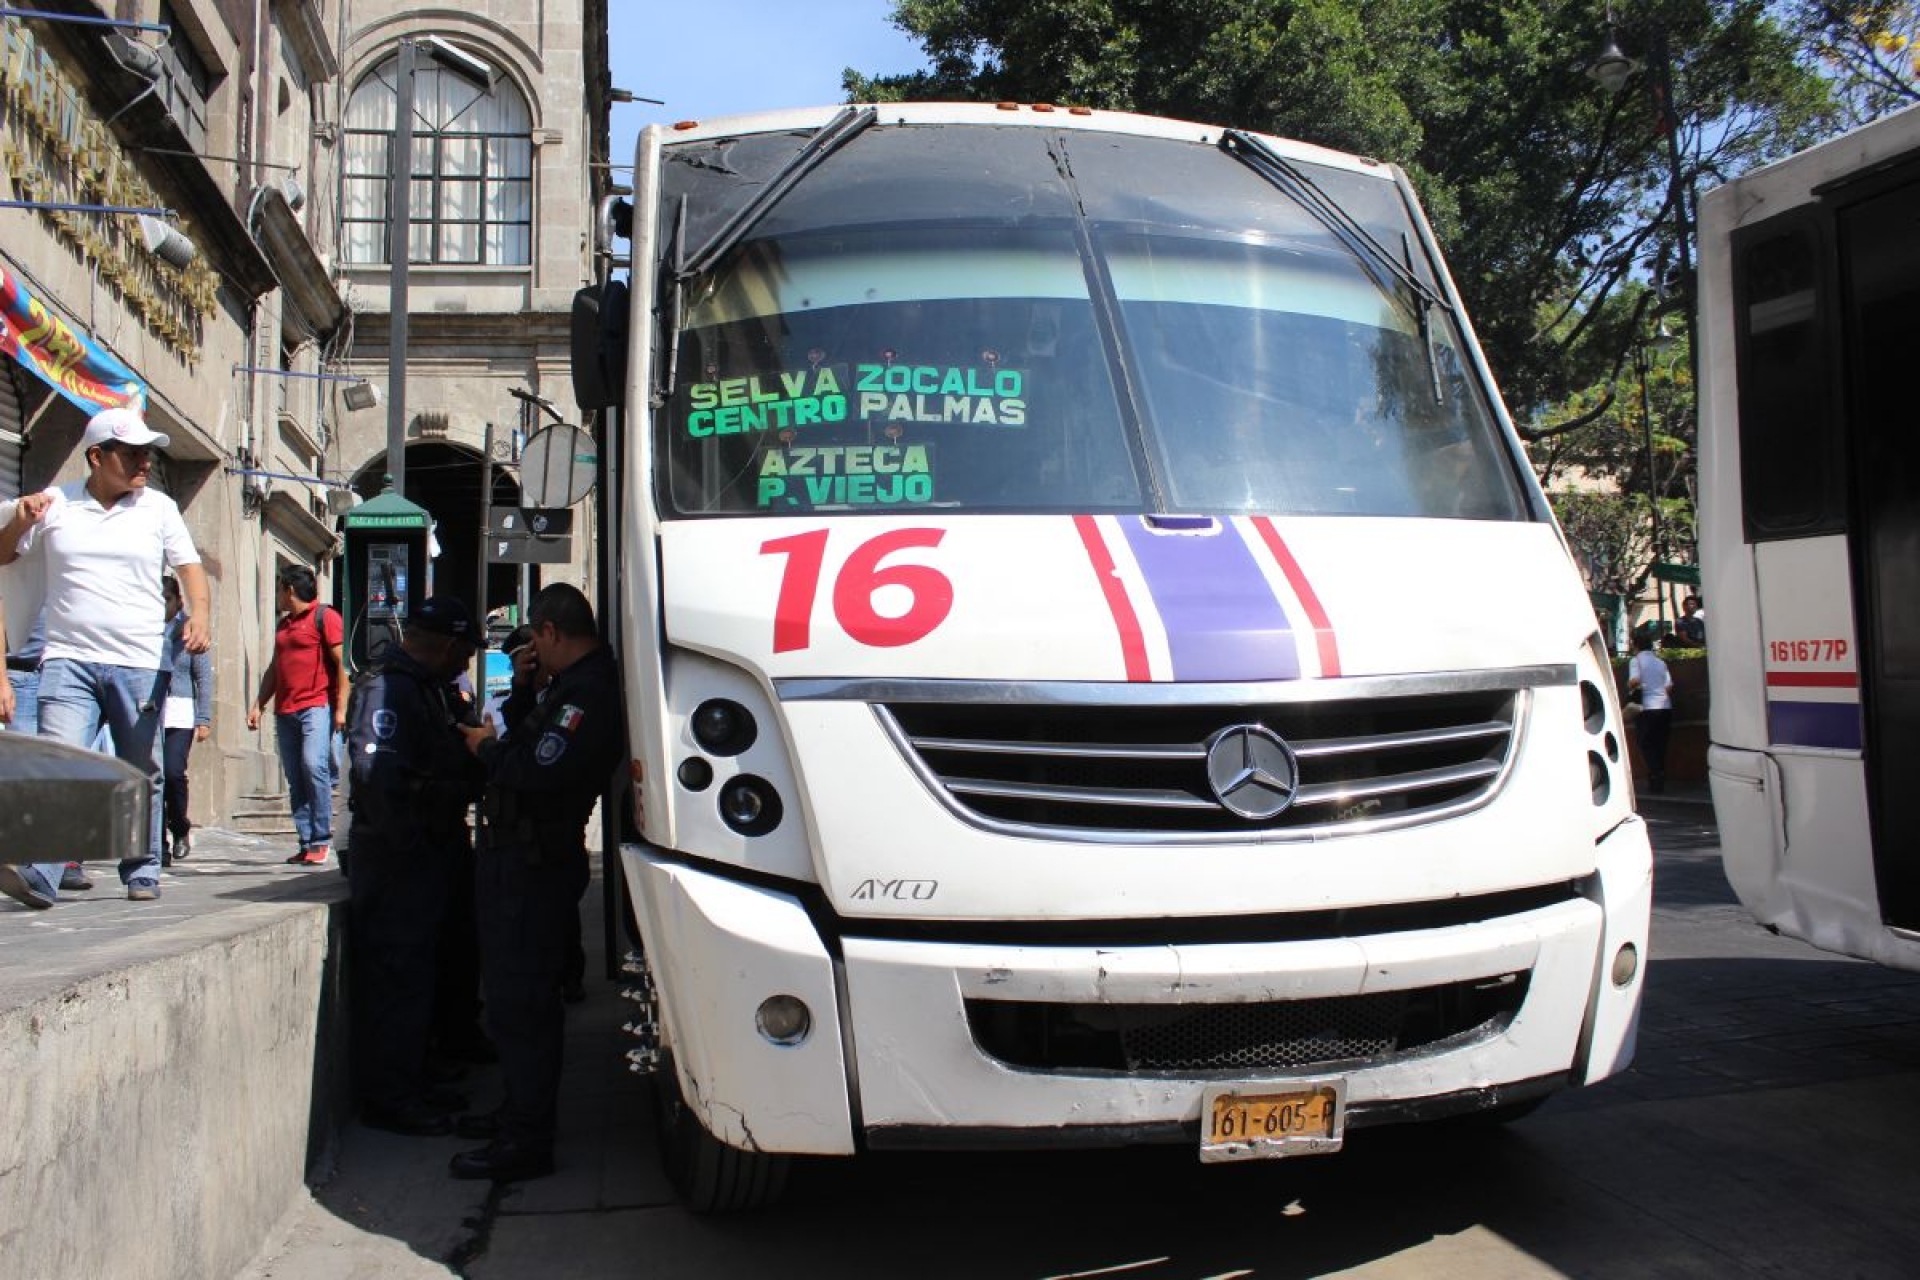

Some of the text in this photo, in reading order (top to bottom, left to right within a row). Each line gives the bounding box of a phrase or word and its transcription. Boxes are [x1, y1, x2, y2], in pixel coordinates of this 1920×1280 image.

[690, 368, 841, 409] SELVA
[857, 364, 1022, 398] ZOCALO
[687, 395, 847, 437] CENTRO
[860, 392, 1025, 425] PALMAS
[759, 445, 929, 476] AZTECA
[759, 527, 954, 654] 16
[1770, 639, 1848, 662] 161677P
